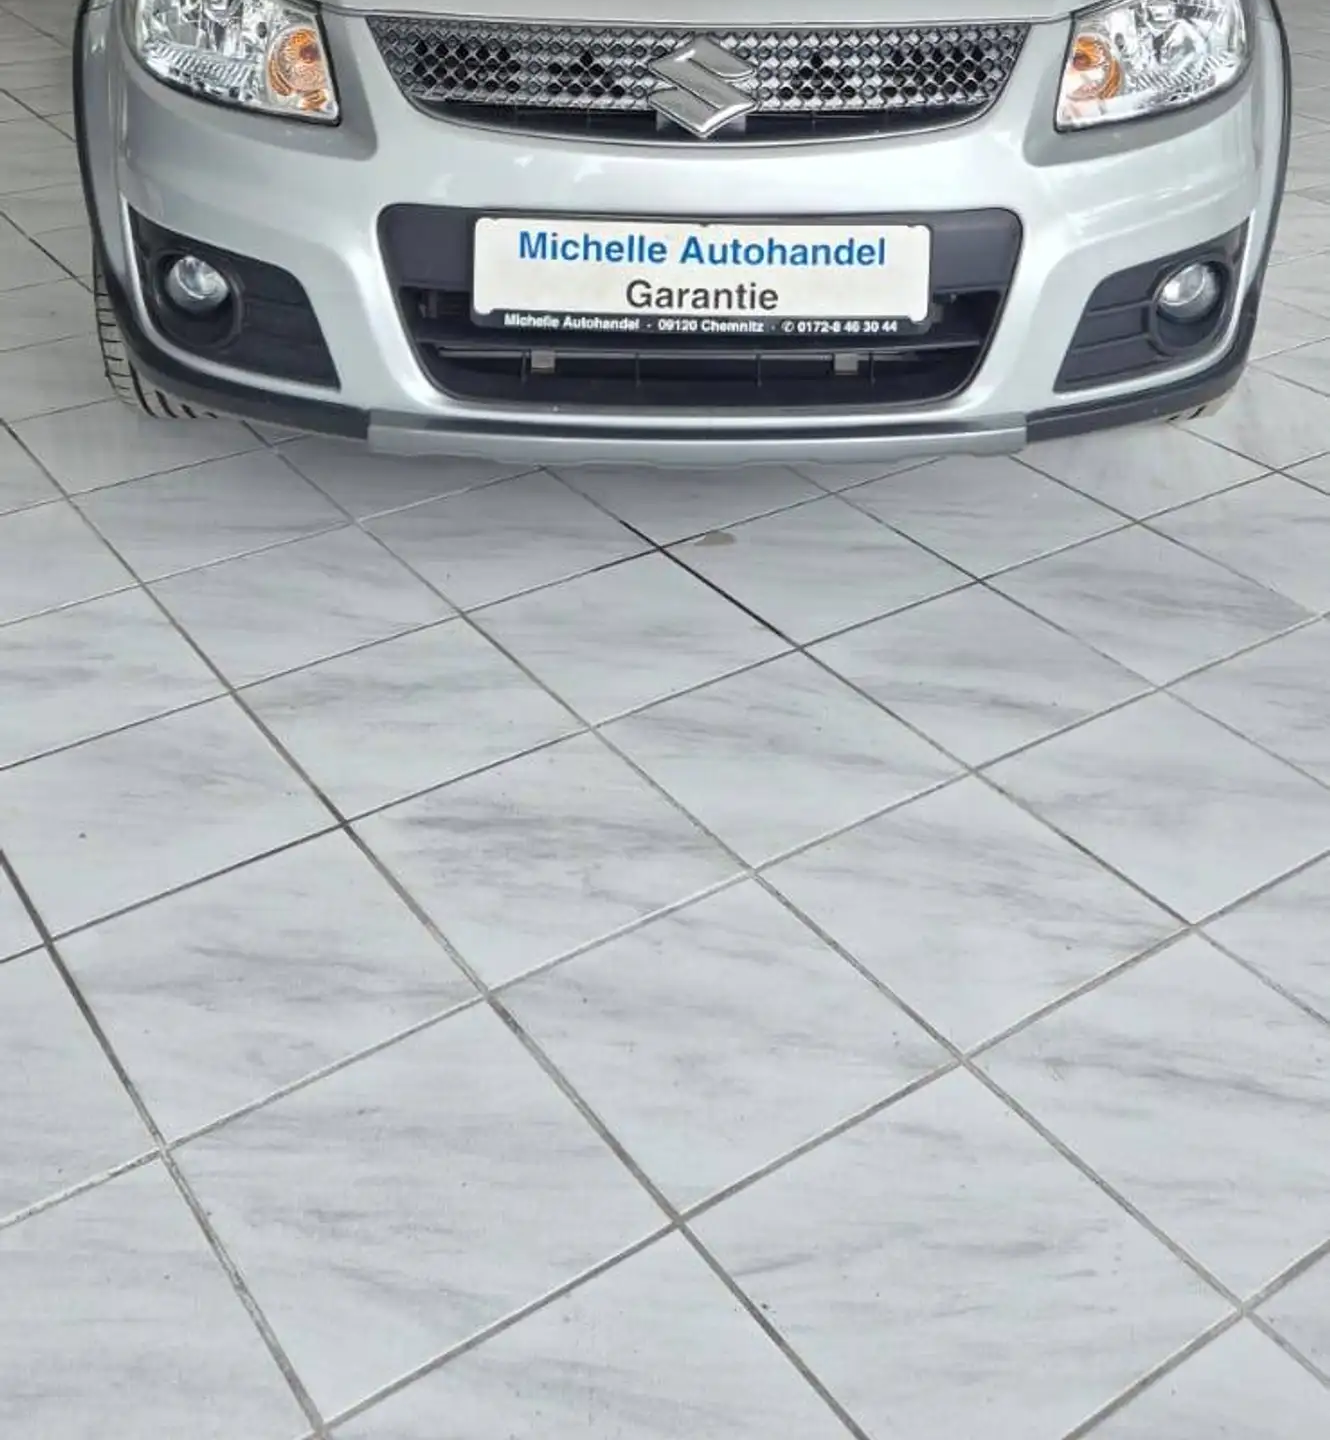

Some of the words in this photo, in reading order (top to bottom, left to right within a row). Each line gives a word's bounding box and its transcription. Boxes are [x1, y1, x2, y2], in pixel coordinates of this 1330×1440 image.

[518, 231, 668, 264] Michelle
[680, 235, 886, 266] Autohandel
[625, 279, 779, 311] Garantie
[504, 313, 559, 329] Michelle
[563, 316, 640, 331] Autohandel
[658, 318, 697, 331] 09120
[701, 319, 764, 333] Chemnitz
[882, 321, 898, 333] 44
